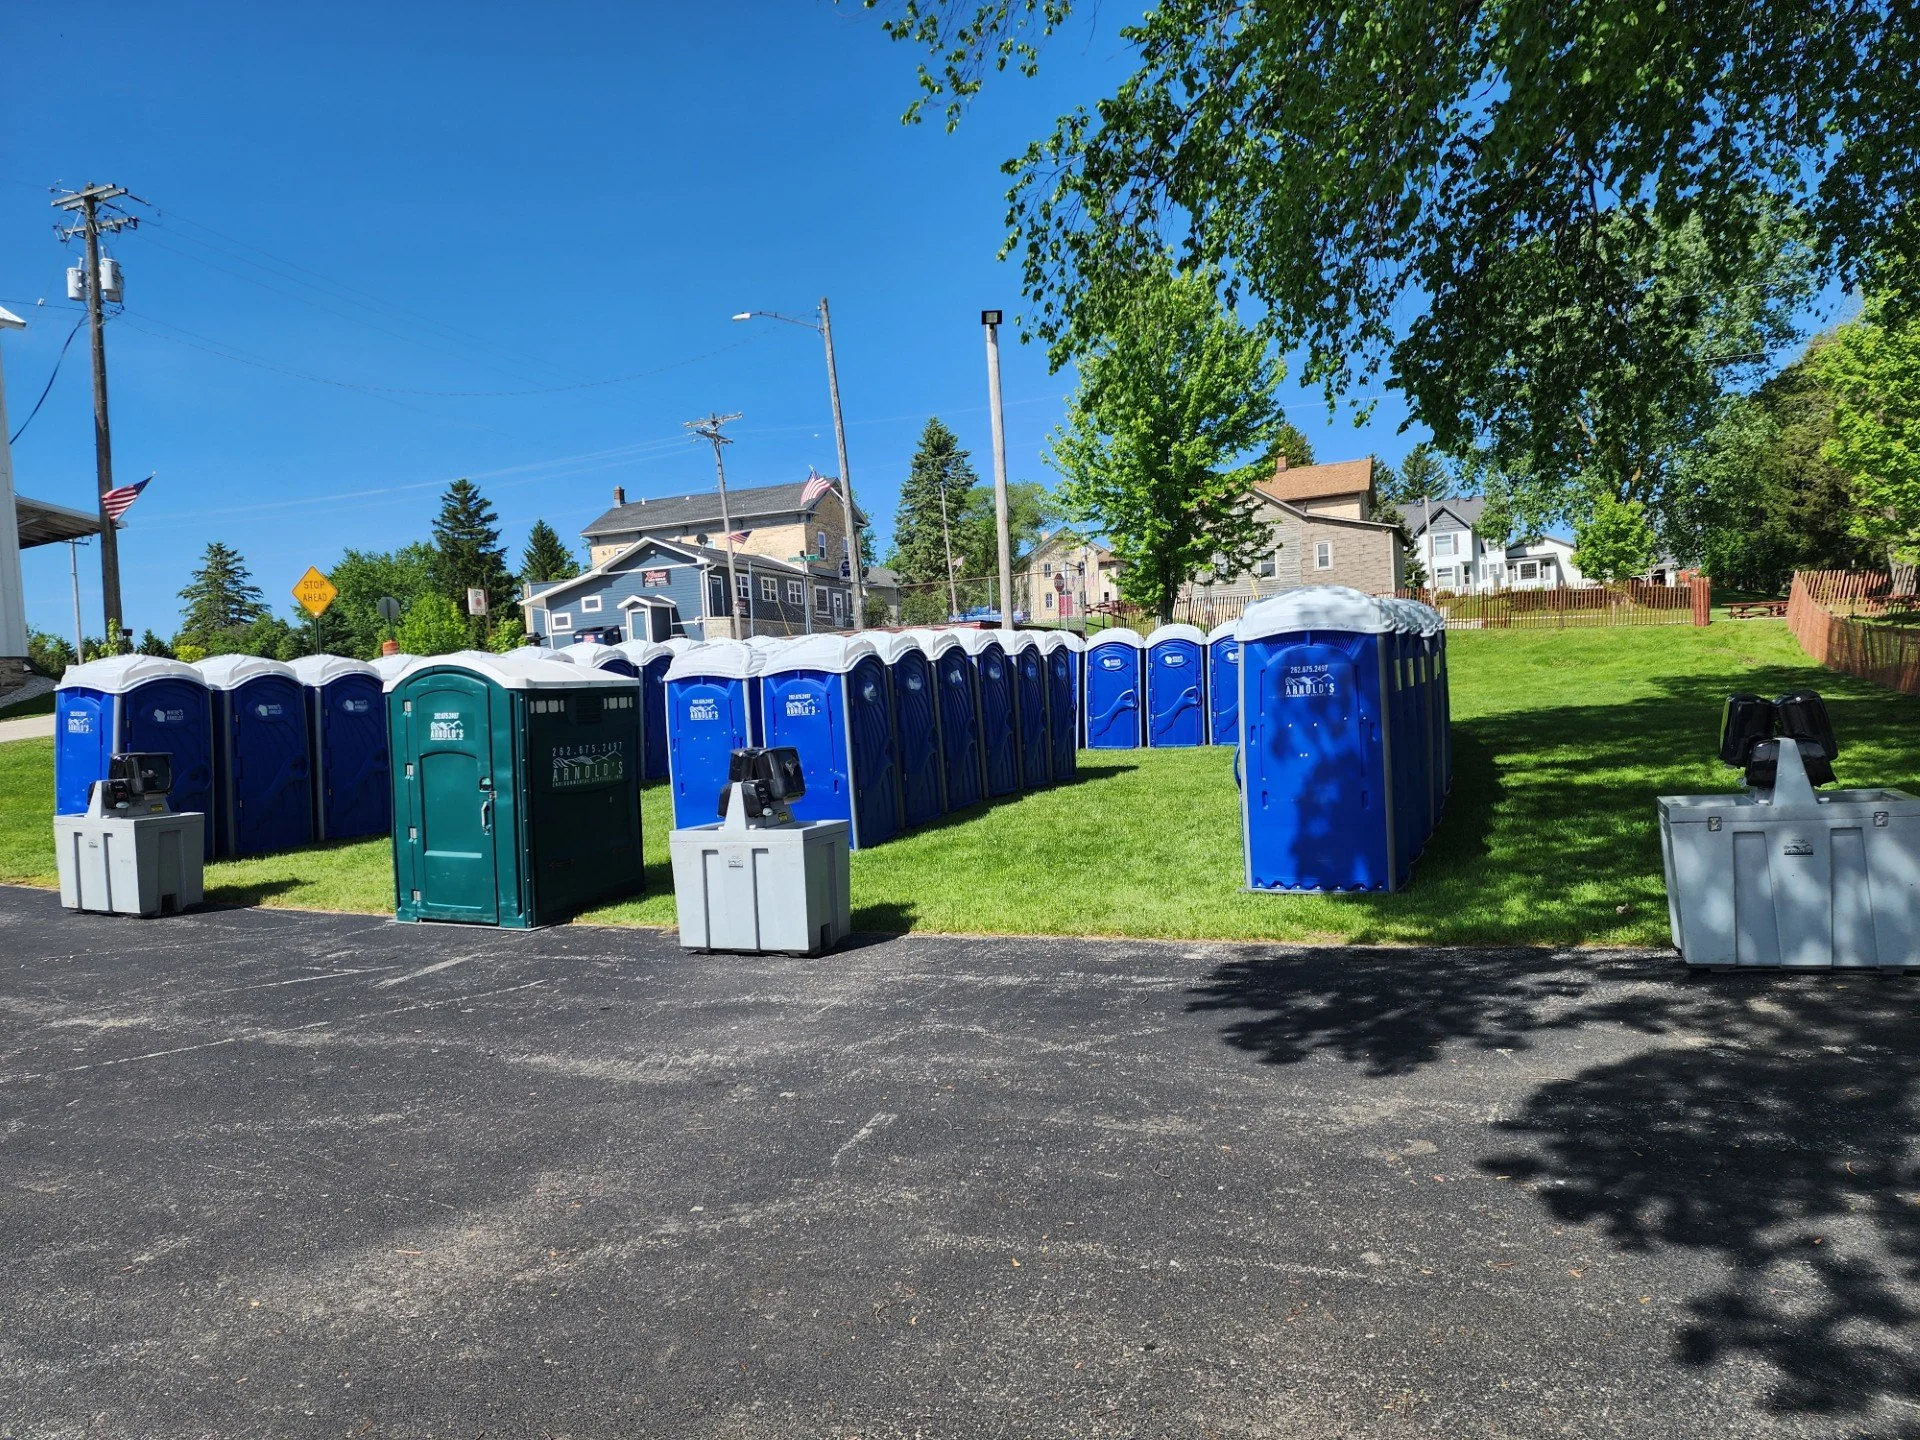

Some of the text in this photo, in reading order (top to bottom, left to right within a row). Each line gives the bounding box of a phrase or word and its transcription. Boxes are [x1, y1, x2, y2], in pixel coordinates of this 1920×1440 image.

[303, 580, 325, 589] STOP
[302, 593, 327, 602] AHEAD
[1285, 682, 1335, 695] ARNOLD'S
[430, 729, 464, 738] ARNOLD'S
[552, 741, 623, 757] 262.675.2497
[552, 761, 623, 782] ARNOLD'S
